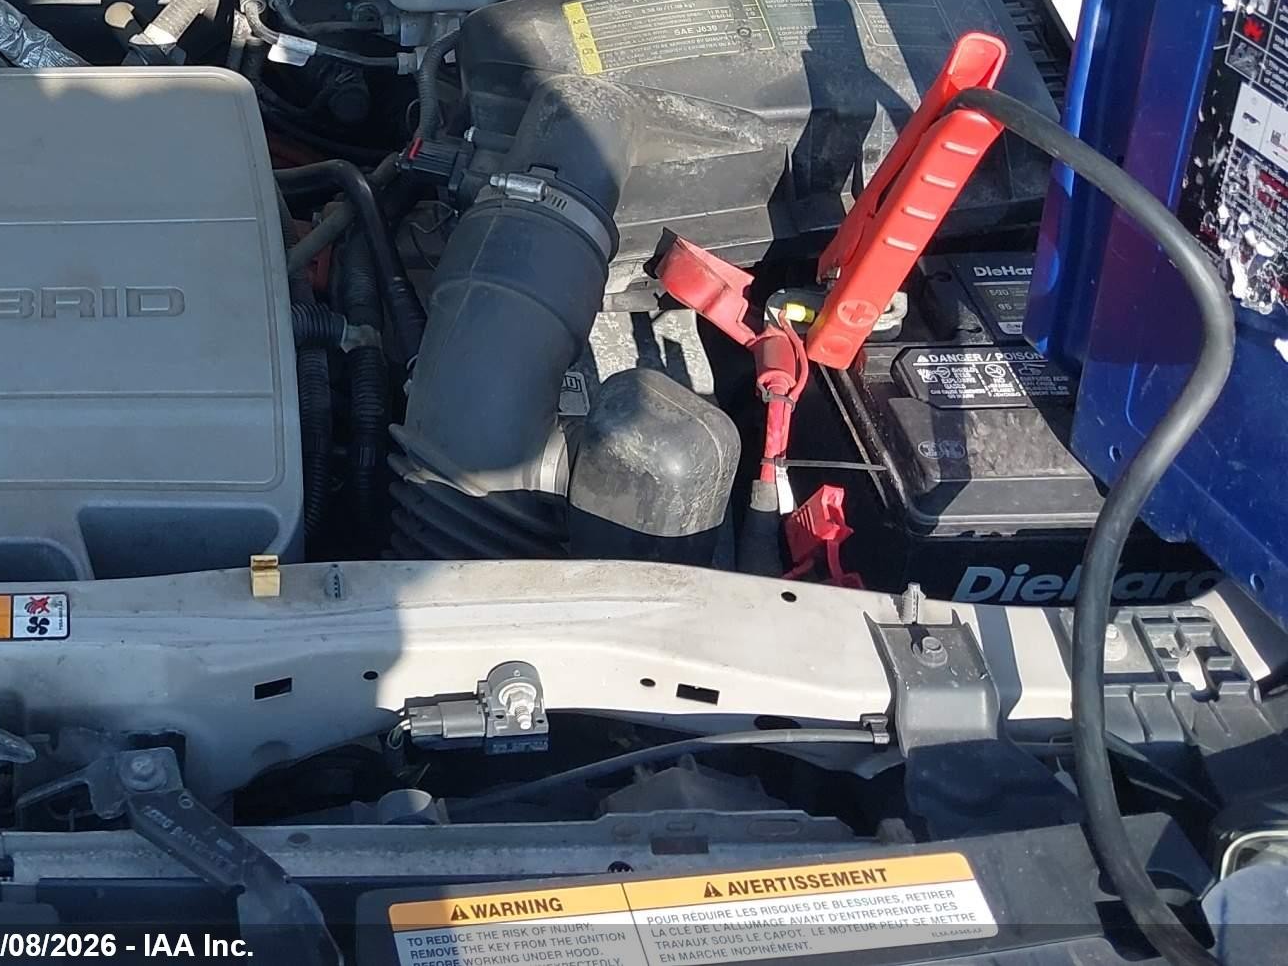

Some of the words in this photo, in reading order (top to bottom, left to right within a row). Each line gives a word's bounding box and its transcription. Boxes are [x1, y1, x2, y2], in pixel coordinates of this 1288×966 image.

[674, 26, 693, 36] SAE
[973, 266, 1033, 276] DieHar
[928, 354, 984, 362] DANGER
[994, 352, 1045, 362] POISON
[728, 868, 887, 896] AVERTISSEMENT
[470, 897, 563, 919] WARNING
[647, 914, 680, 926] POUR
[736, 907, 758, 918] LES
[760, 902, 810, 914] RISQUES
[813, 900, 830, 910] DE
[832, 894, 904, 909] BLESSURES,
[906, 890, 956, 902] RETIRER
[651, 928, 667, 938] LA
[694, 924, 710, 934] DE
[712, 917, 788, 932] L'ALLUMAGE
[790, 914, 825, 925] AVANT
[828, 904, 932, 922] D'ENTREPRENDRE
[934, 902, 958, 912] DES
[654, 937, 710, 950] TRAVAUX
[711, 934, 744, 945] SOUS
[746, 932, 760, 942] LE
[764, 928, 806, 940] CAPOT.
[810, 926, 826, 936] LE
[828, 922, 878, 935] MOTEUR
[880, 919, 910, 930] PEUT
[912, 917, 928, 926] SE
[932, 912, 977, 924] METTRE
[408, 937, 423, 948] TO
[426, 933, 473, 946] REDUCE
[476, 930, 500, 940] THE
[502, 928, 528, 938] RISK
[532, 926, 548, 936] OF
[411, 946, 459, 960] REMOVE
[462, 944, 485, 954] THE
[488, 942, 511, 952] KEY
[515, 939, 547, 950] FROM
[551, 936, 573, 946] THE
[576, 932, 626, 946] IGNITION
[462, 954, 520, 966] WORKING
[523, 950, 562, 962] UNDER
[565, 947, 604, 958] HOOD.
[660, 953, 676, 963] EN
[678, 948, 728, 962] MARCHE
